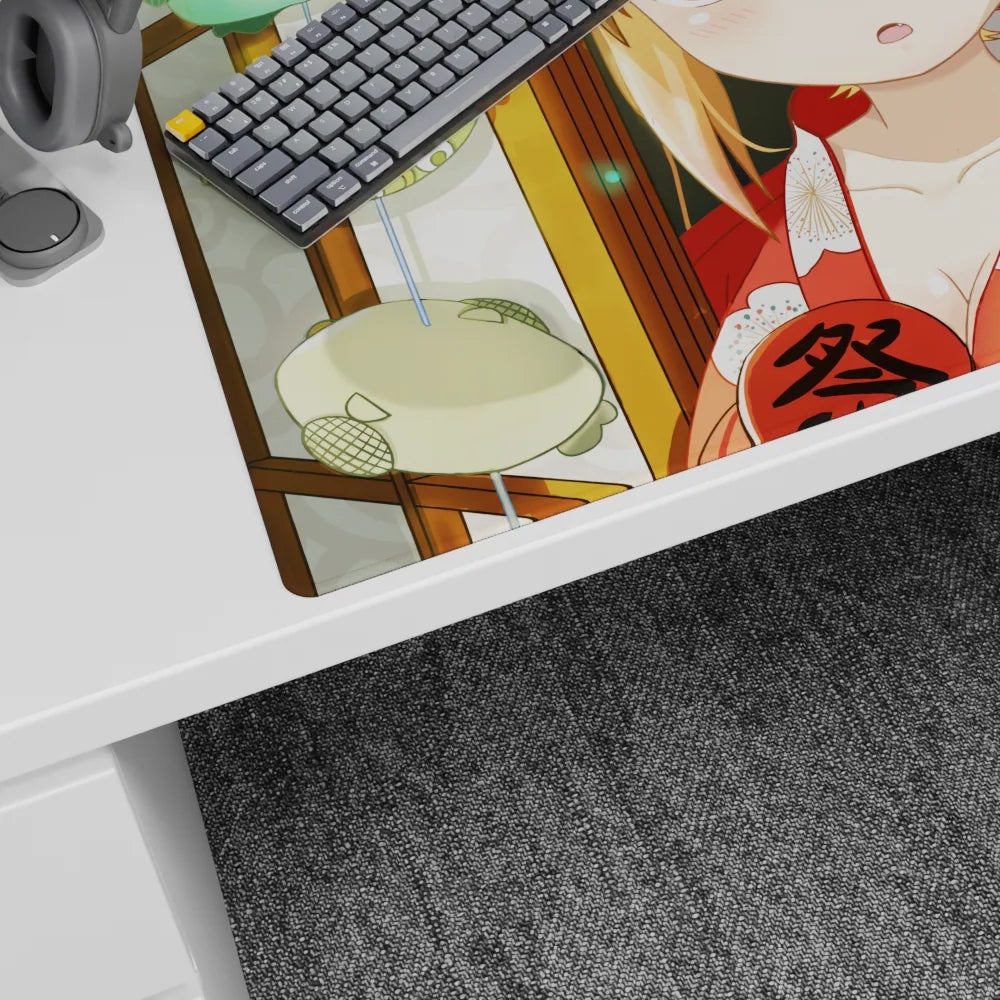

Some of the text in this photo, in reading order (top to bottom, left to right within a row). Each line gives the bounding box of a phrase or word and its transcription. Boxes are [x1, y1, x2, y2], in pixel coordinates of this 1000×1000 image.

[354, 148, 379, 168] command
[284, 174, 297, 185] shift
[326, 176, 344, 189] option
[292, 199, 311, 215] control
